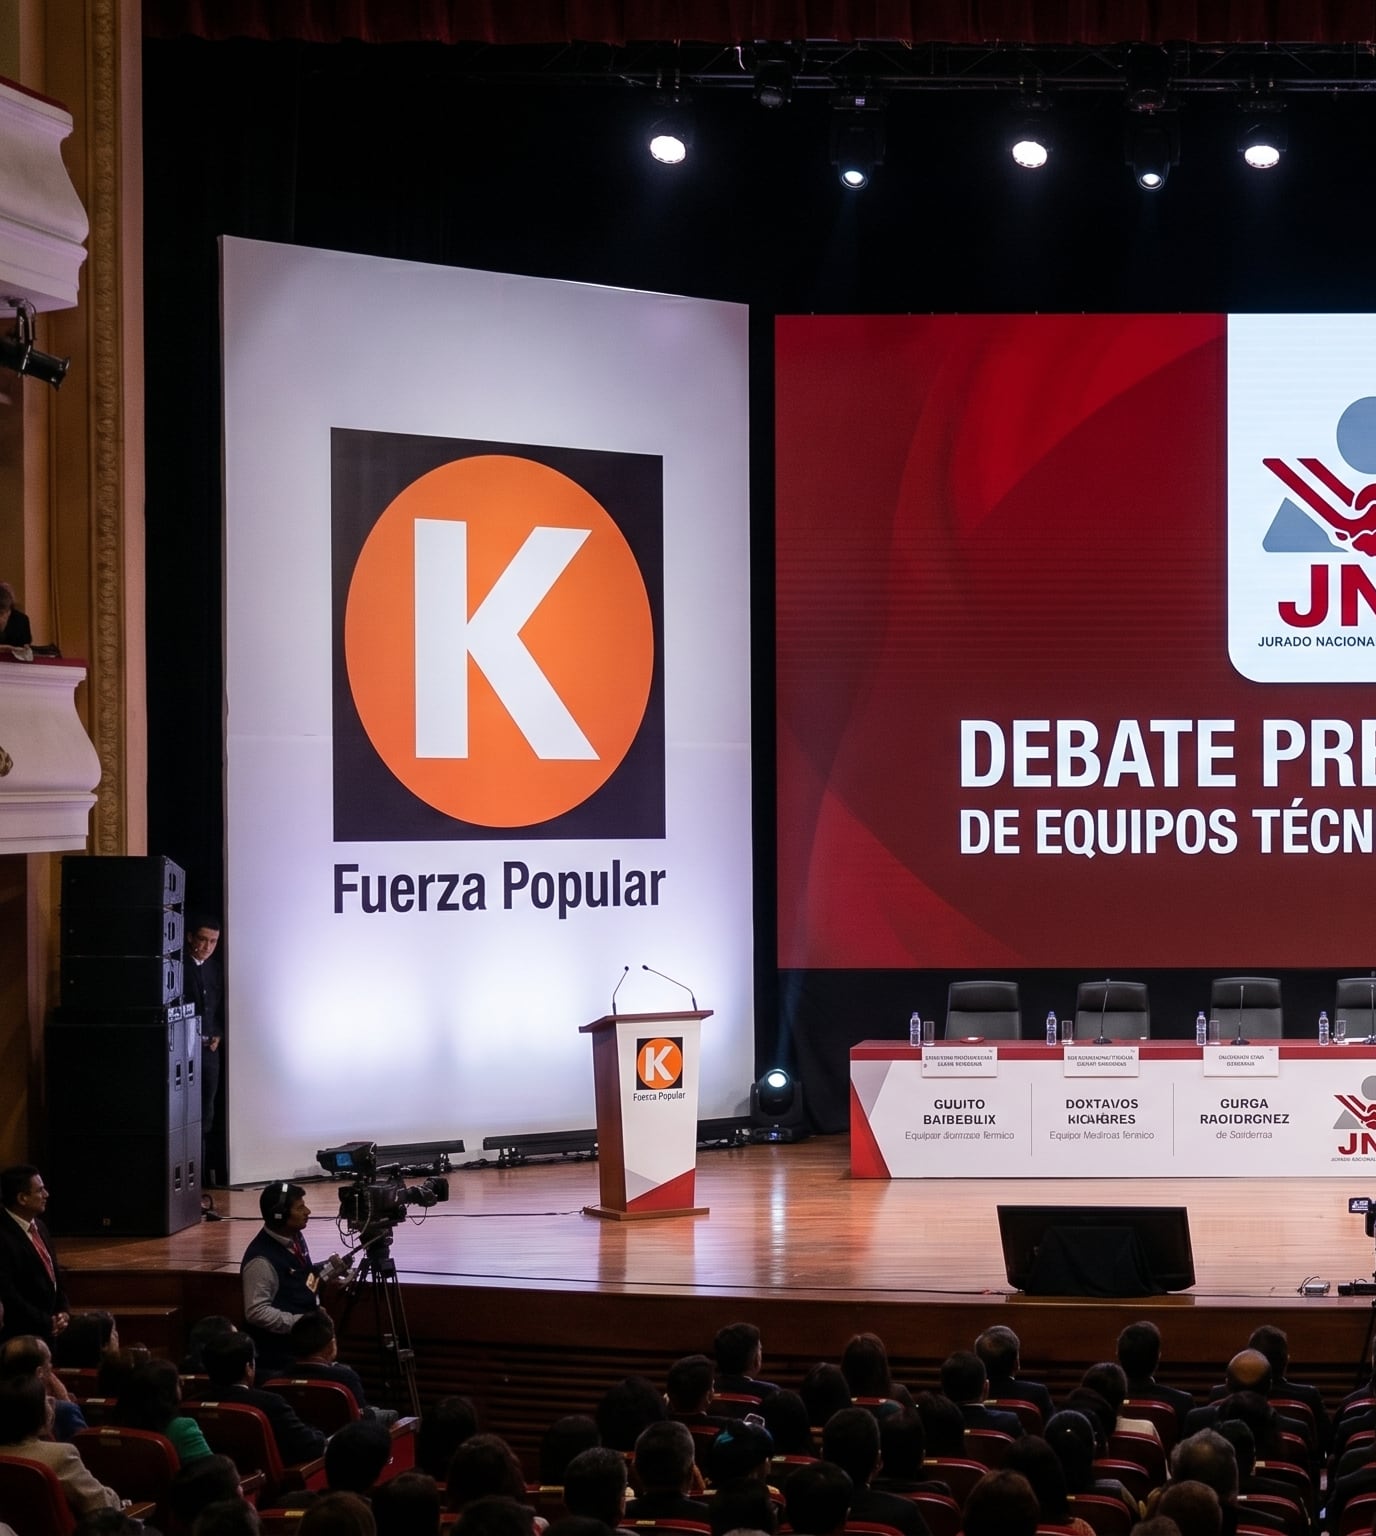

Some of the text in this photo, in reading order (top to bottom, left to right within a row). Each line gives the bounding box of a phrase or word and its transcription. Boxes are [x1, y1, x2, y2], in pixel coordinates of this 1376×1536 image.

[414, 517, 601, 761] K
[1258, 636, 1312, 647] JURADO
[959, 718, 1237, 788] DEBATE
[959, 808, 1024, 855] DE
[1035, 807, 1238, 860] EQUIPOS
[333, 859, 667, 920] Fuerza Popular
[645, 1046, 674, 1081] K
[658, 1091, 686, 1101] Popular
[1220, 1098, 1269, 1109] GURGA
[1216, 1130, 1228, 1139] de
